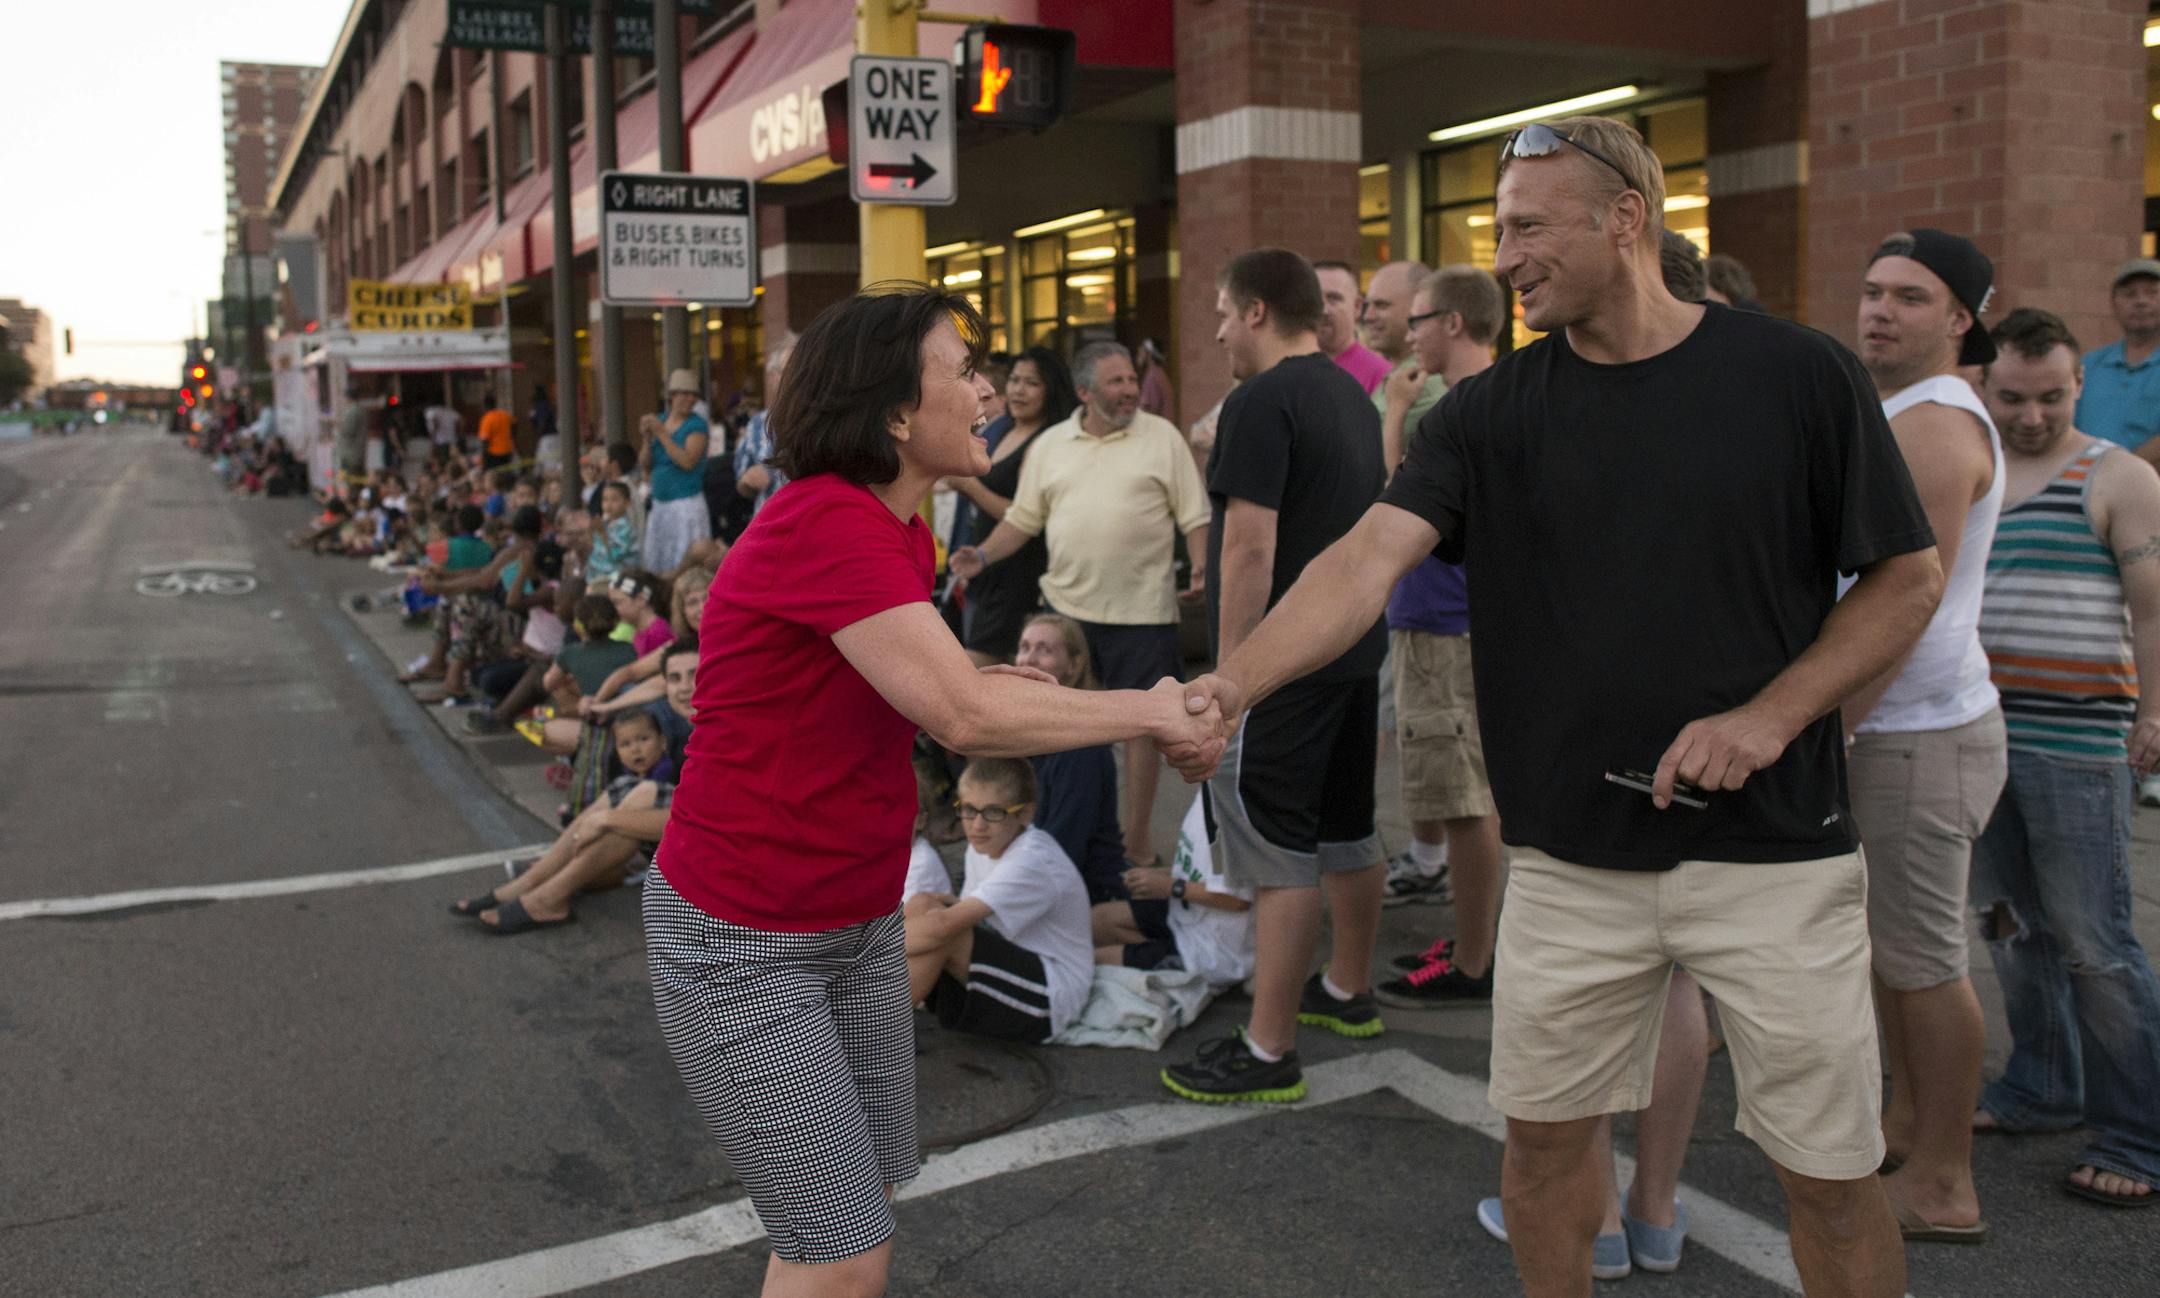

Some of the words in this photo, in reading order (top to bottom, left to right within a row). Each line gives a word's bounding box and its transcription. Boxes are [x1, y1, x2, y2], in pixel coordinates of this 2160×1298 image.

[867, 66, 939, 101] ONE
[866, 106, 940, 141] WAY
[633, 183, 688, 208] RIGHT
[693, 187, 743, 209] LANE
[692, 225, 743, 245] BIKES
[688, 249, 746, 268] TURNS
[355, 309, 466, 328] CURDS
